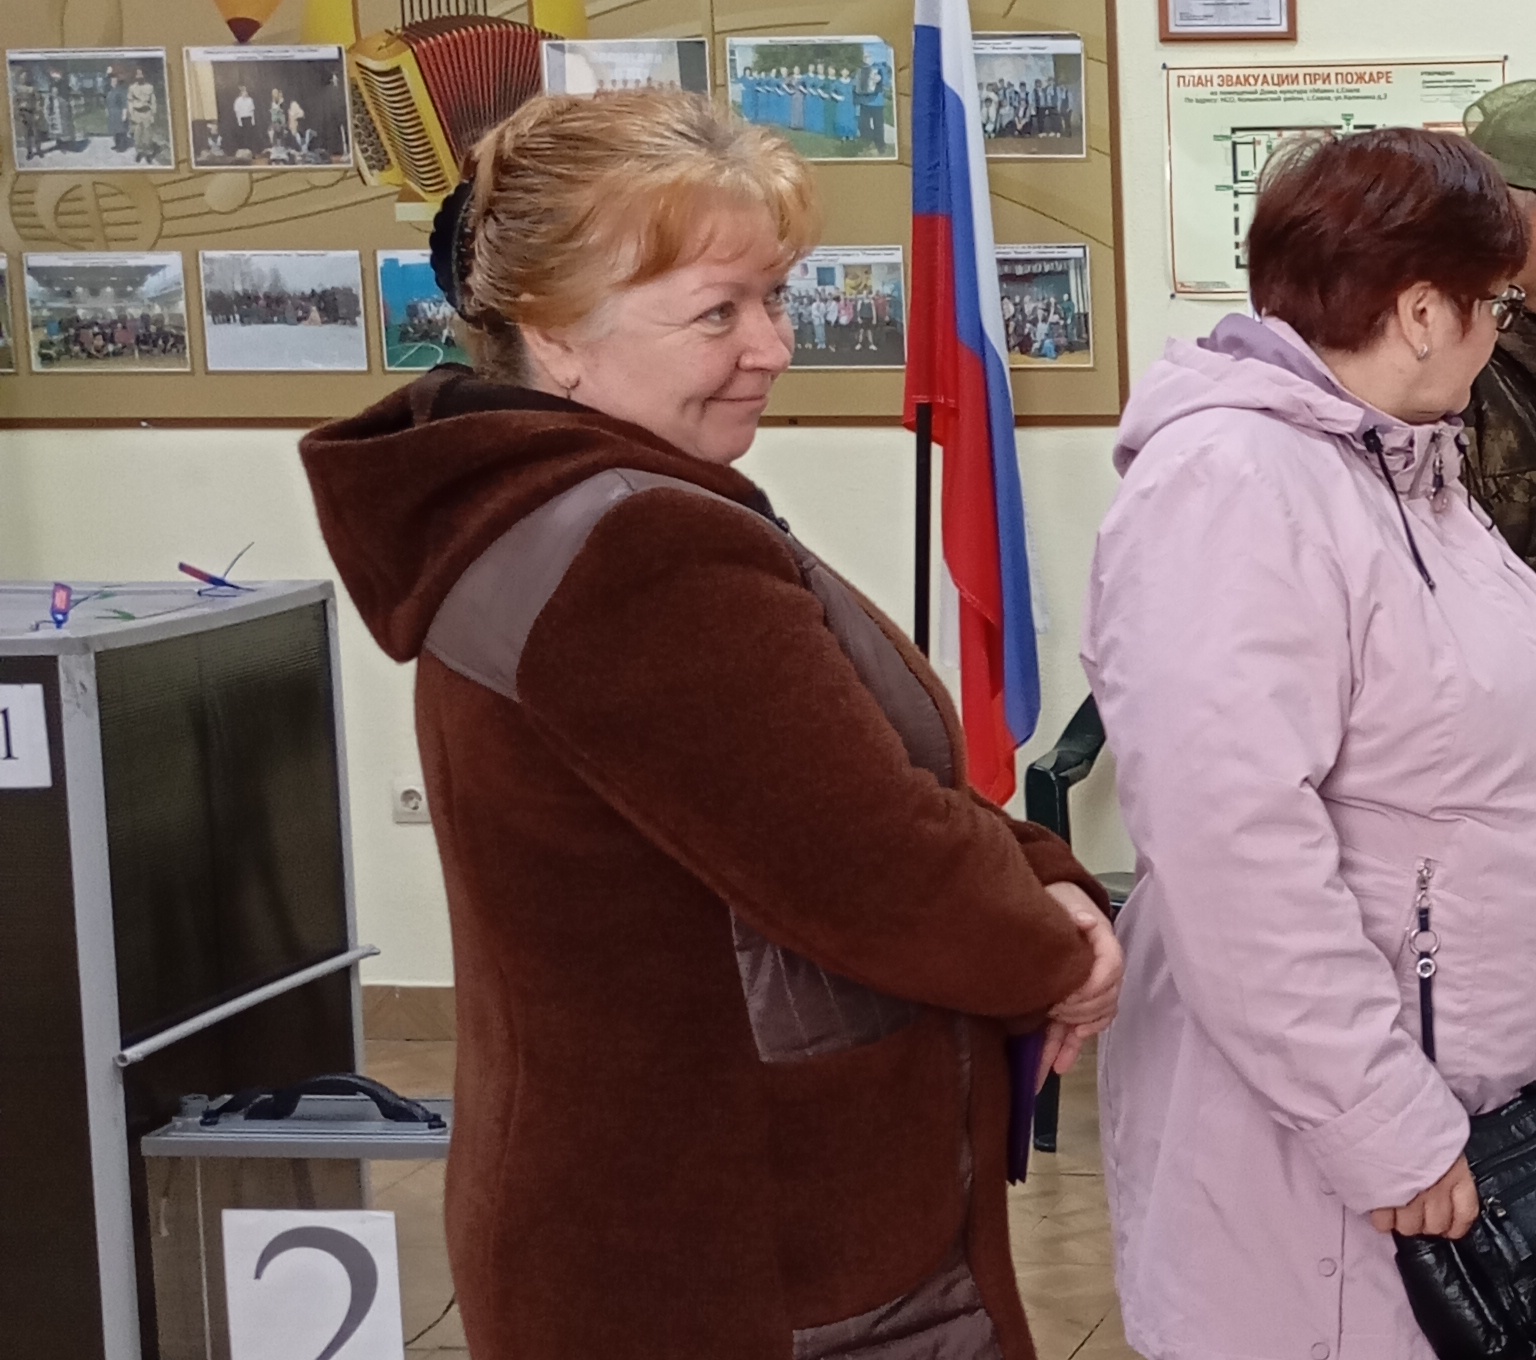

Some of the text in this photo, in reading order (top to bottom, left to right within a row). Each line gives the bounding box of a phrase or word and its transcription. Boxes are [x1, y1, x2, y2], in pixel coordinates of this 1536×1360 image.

[1177, 70, 1393, 88] ПЛАН ЭВАКУАЦИИ ПРИ ПОЖАРЕ
[1, 707, 17, 760] 1
